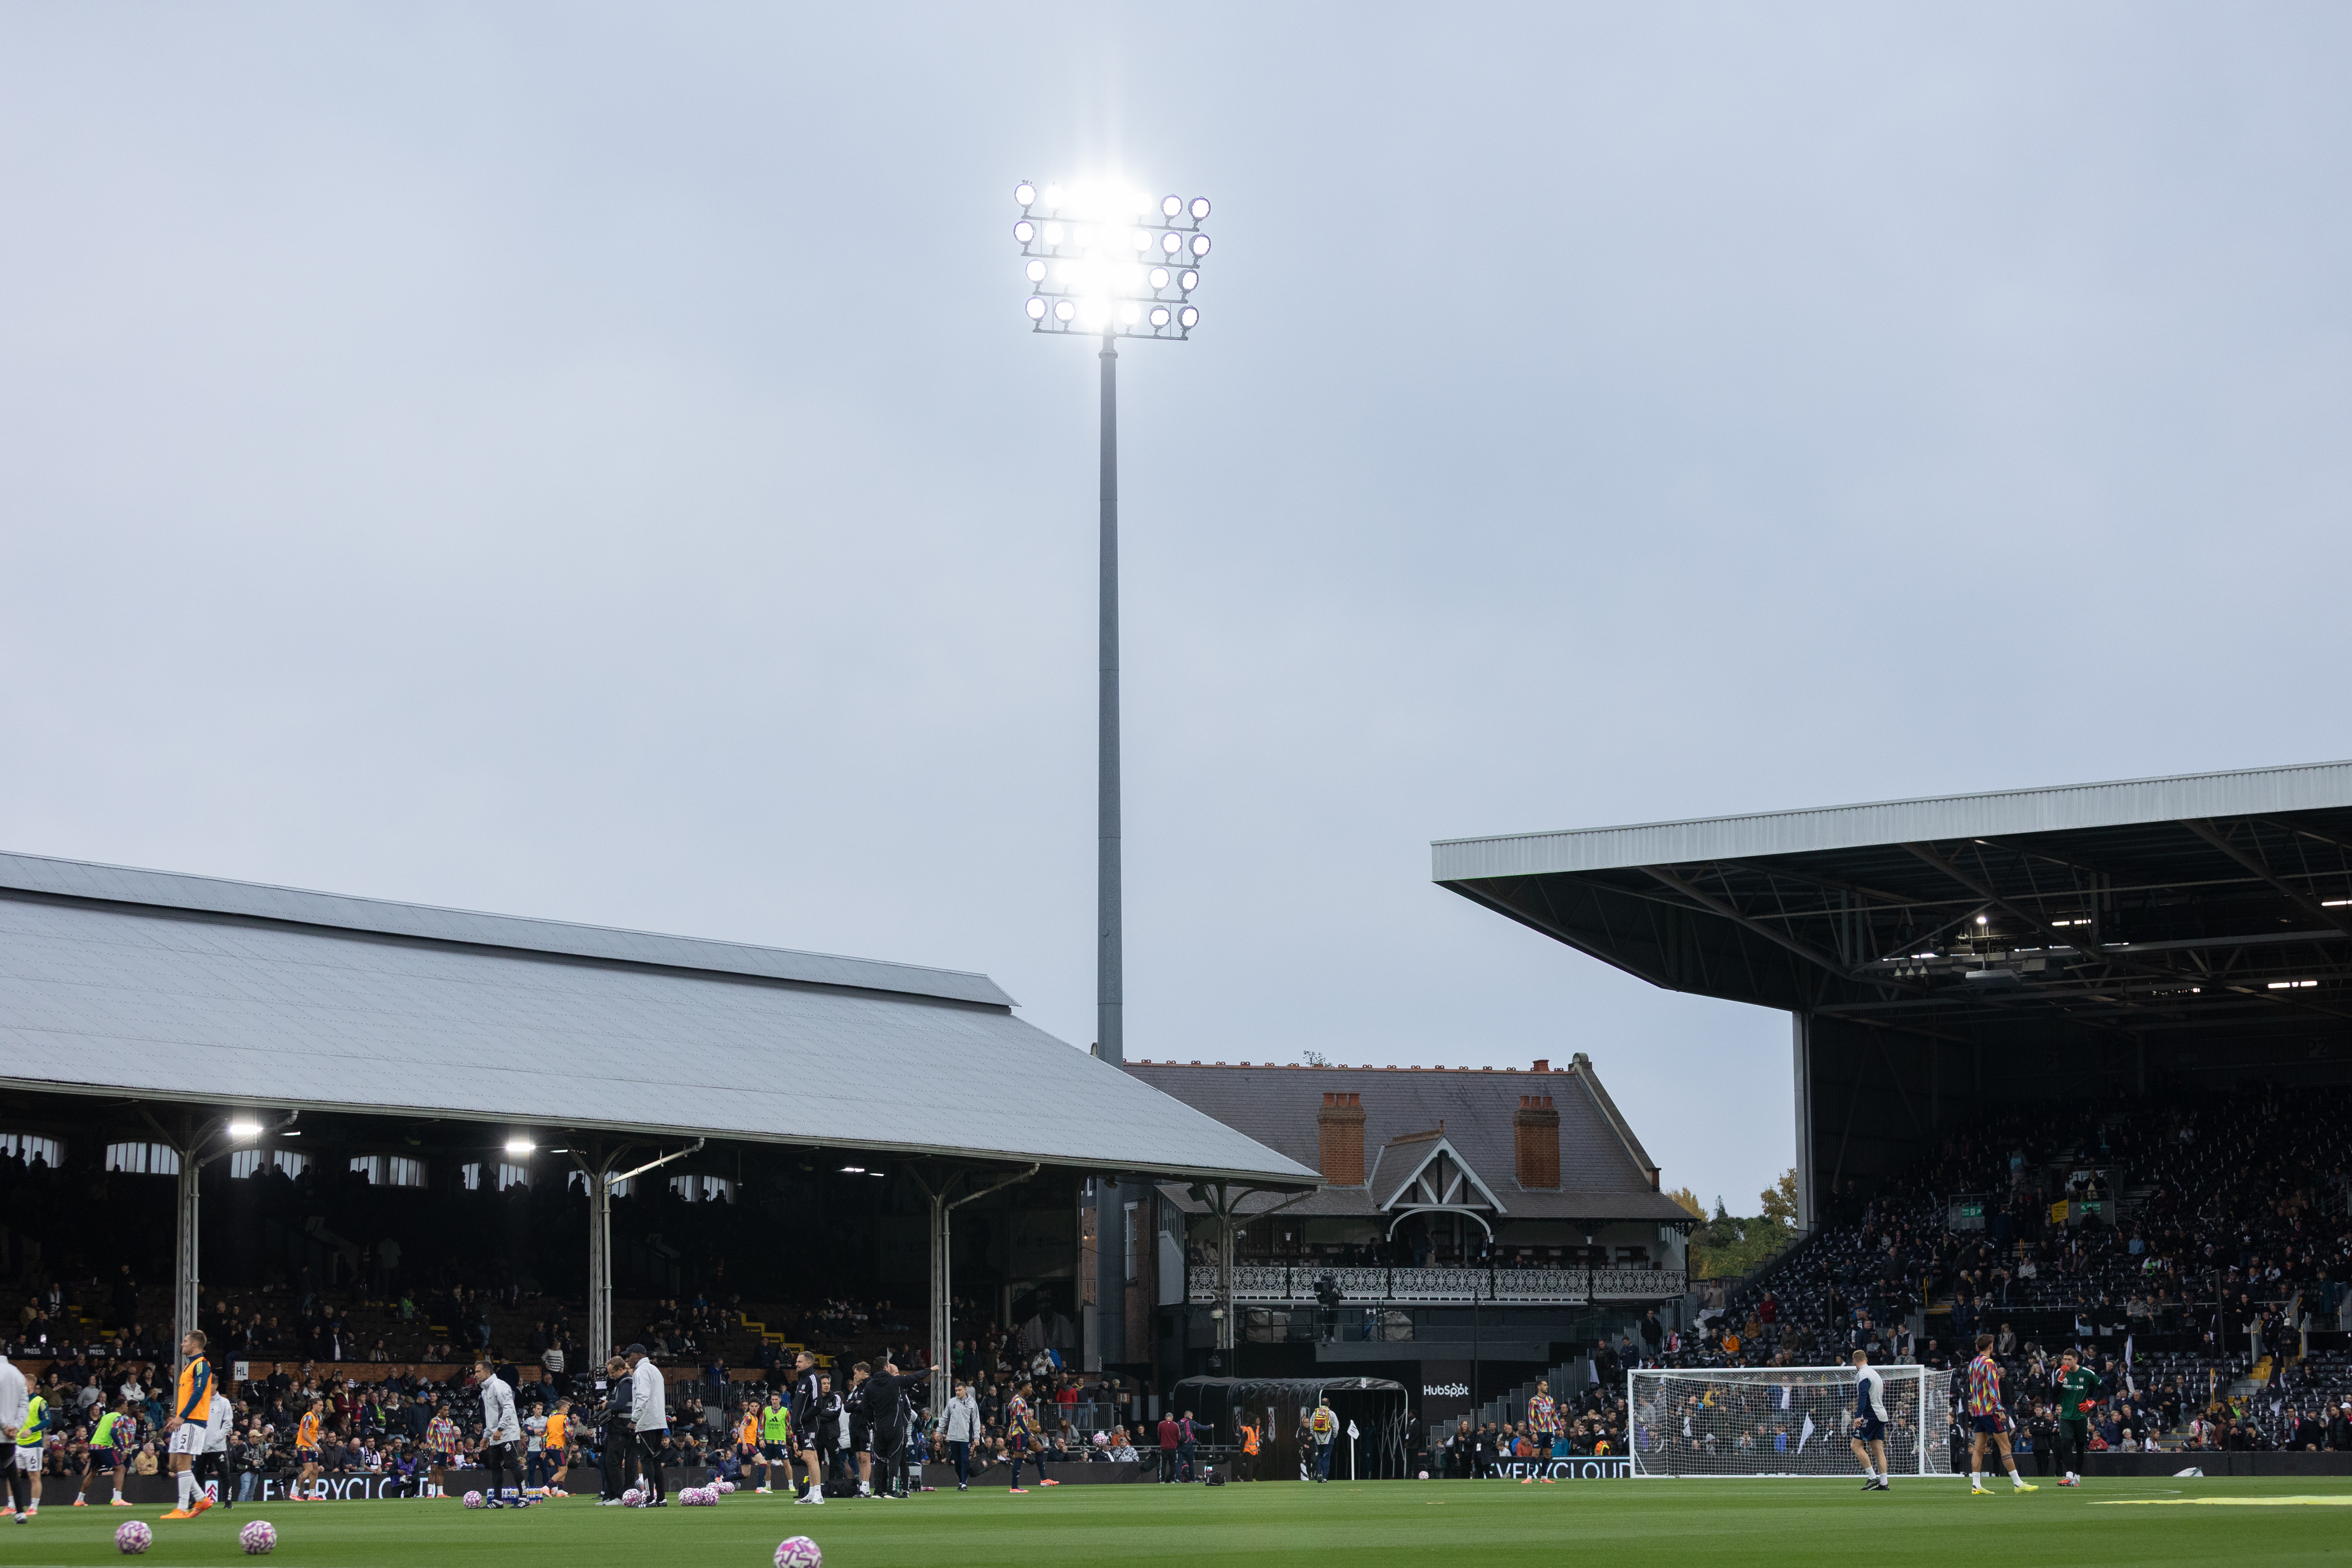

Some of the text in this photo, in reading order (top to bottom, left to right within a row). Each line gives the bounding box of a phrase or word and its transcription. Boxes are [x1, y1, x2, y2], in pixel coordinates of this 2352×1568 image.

[2306, 1038, 2328, 1057] P2
[2068, 1173, 2079, 1184] P1
[236, 1366, 247, 1376] HL
[1424, 1383, 1469, 1397] HubSpot
[181, 1434, 187, 1444] 5
[30, 1455, 37, 1464] 6
[1483, 1462, 1630, 1479] VERYCLOUD
